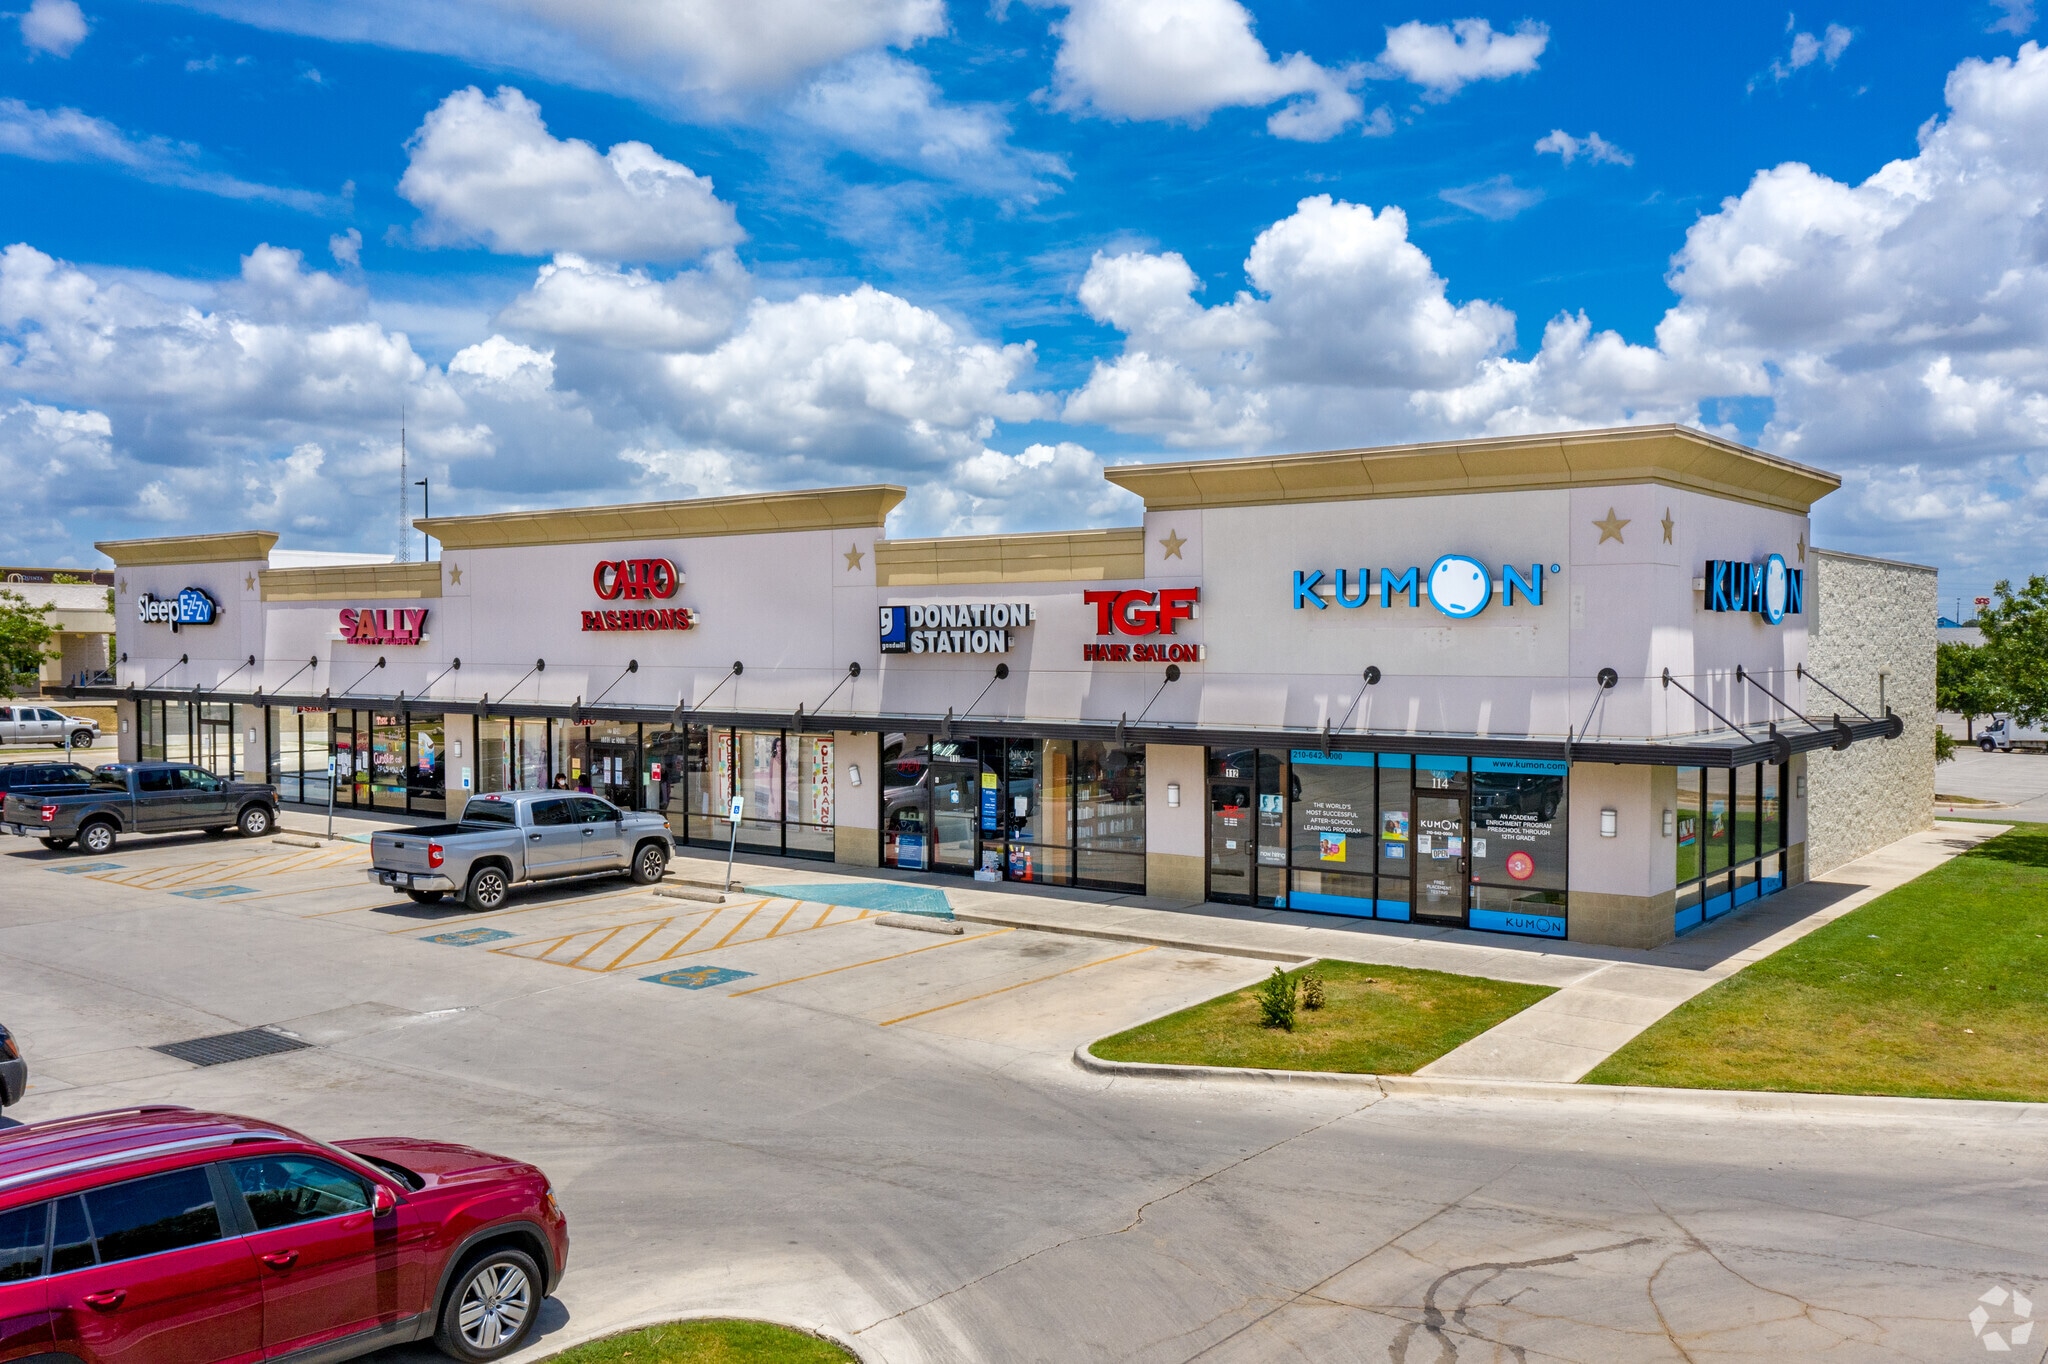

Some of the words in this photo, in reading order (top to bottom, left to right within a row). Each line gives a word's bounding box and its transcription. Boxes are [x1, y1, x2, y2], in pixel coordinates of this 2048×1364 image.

[593, 558, 678, 600] CATO
[1293, 554, 1544, 619] KUMON
[1710, 553, 1803, 625] KUMON
[138, 594, 180, 632] Sleep
[581, 608, 694, 631] FASHIONS
[909, 603, 1028, 628] DONATION
[1083, 587, 1200, 636] TGF
[339, 608, 427, 638] SALLY
[881, 642, 906, 651] goodwill
[910, 629, 1008, 654] STATION
[1083, 643, 1130, 662] HAIR
[1133, 643, 1198, 663] SALON
[1226, 769, 1239, 778] 112
[1493, 760, 1566, 771] www.kumon.com
[820, 745, 831, 832] CLEARANCE
[1432, 778, 1449, 789] 114
[1310, 818, 1354, 826] AFTER-SCHOOL
[1323, 811, 1359, 819] SUCCESSFUL
[1333, 826, 1361, 834] PROGRAM
[1420, 820, 1459, 831] KUMON
[1487, 826, 1521, 834] PRESCHOOL
[1522, 828, 1550, 836] THROUGH
[1271, 851, 1286, 859] hiring
[1505, 917, 1561, 932] KUMON
